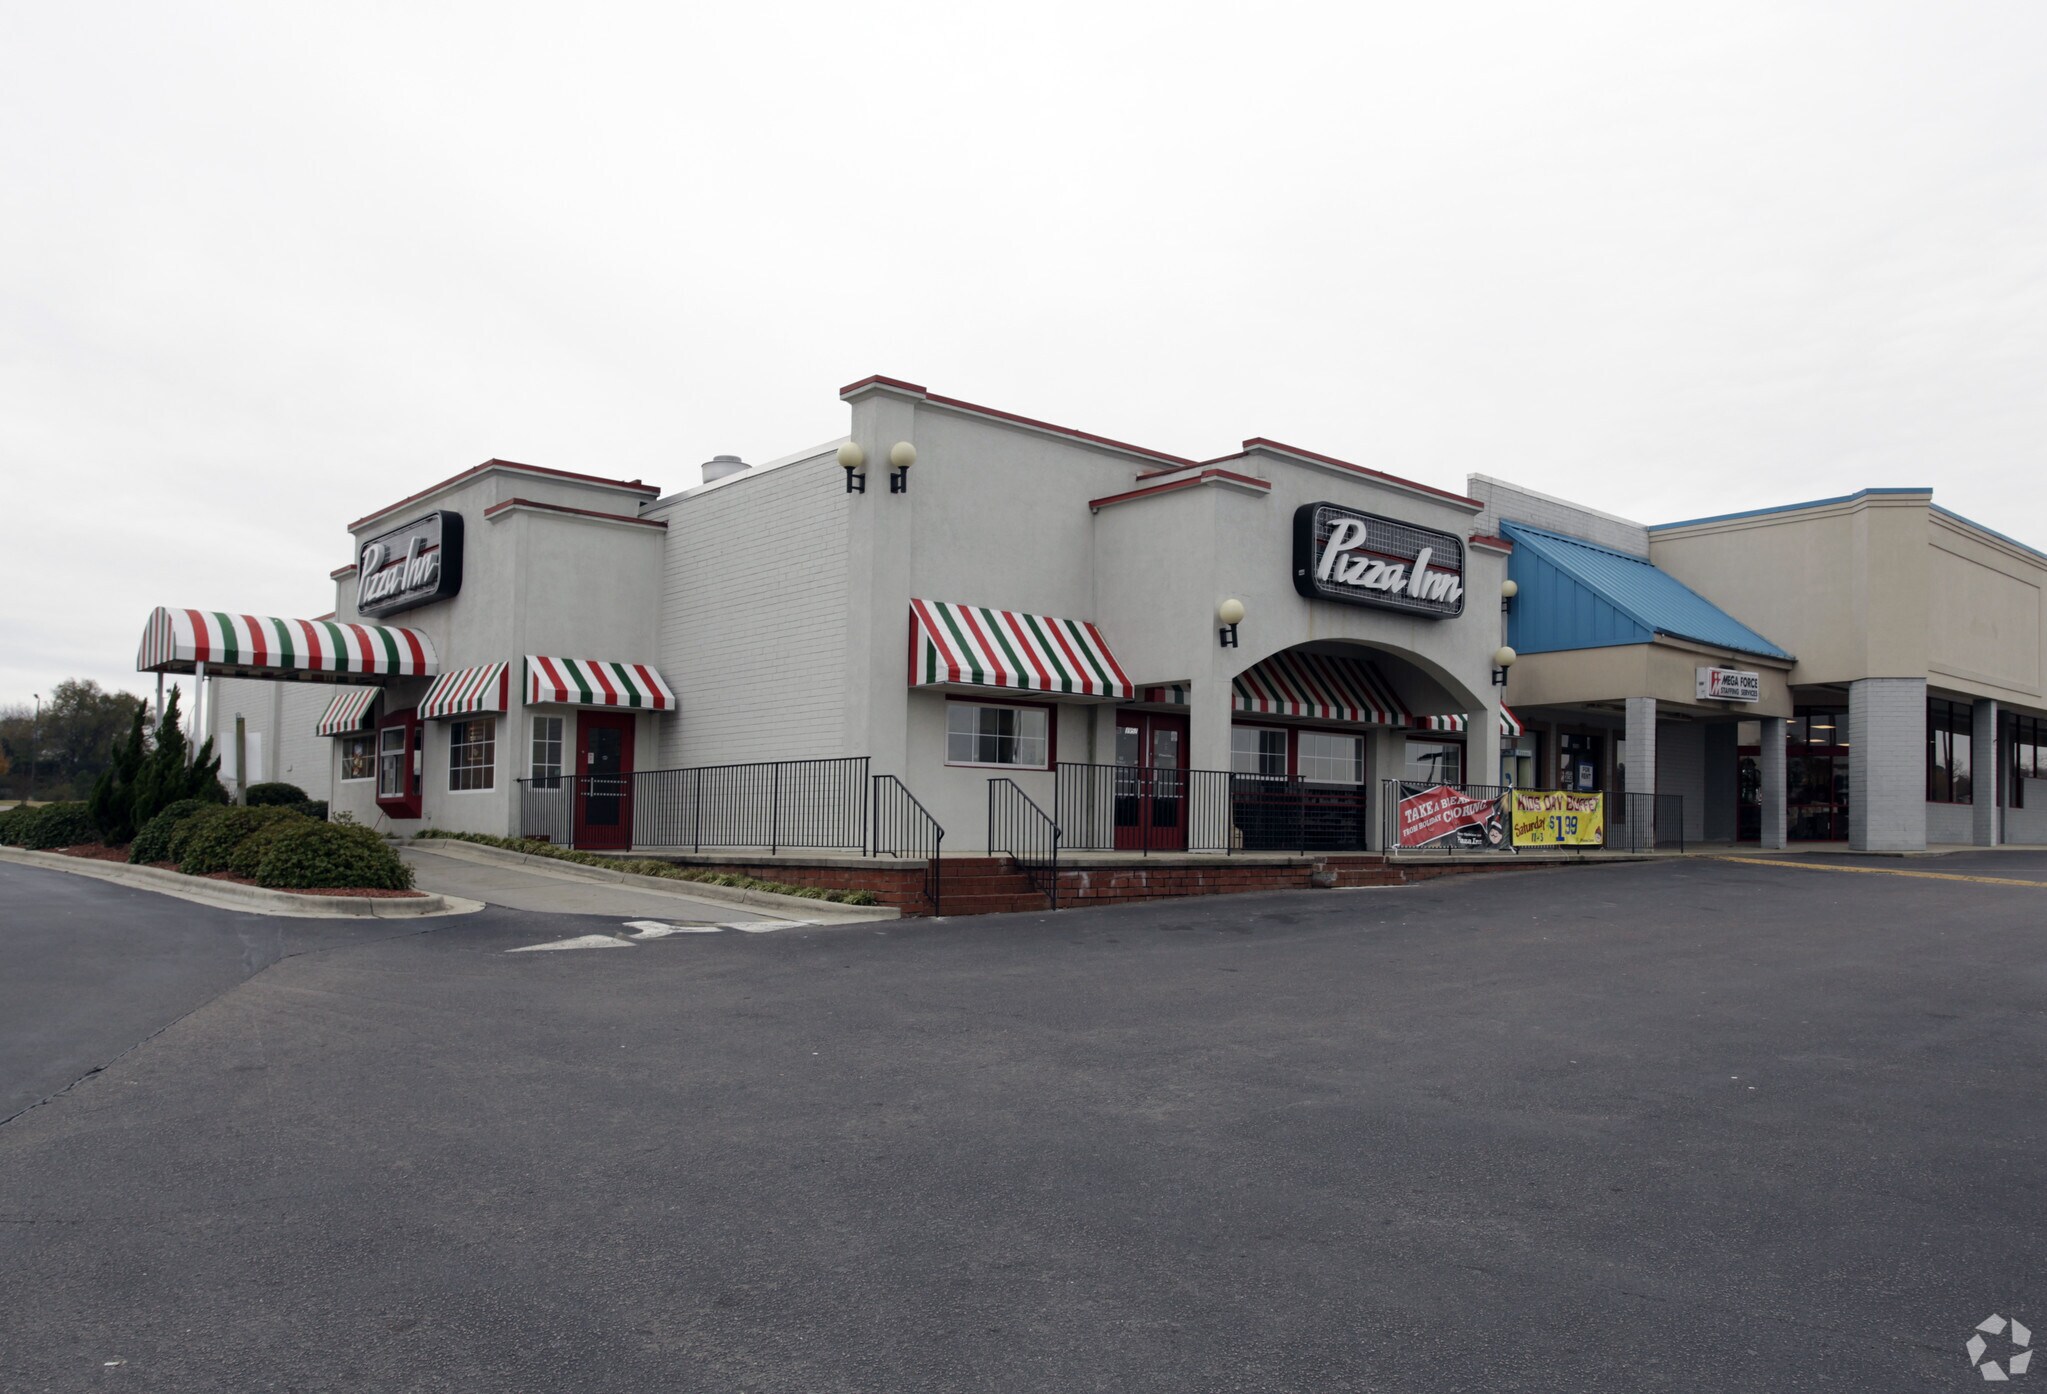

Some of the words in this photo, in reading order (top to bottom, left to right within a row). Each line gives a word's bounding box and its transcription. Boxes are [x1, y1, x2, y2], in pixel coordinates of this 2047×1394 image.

[357, 543, 403, 606] Pizza
[401, 536, 440, 591] Inn
[1317, 518, 1407, 594] Pizza
[1407, 547, 1463, 603] Inn
[1720, 687, 1739, 695] STAFFING
[1740, 689, 1758, 697] SERVICES
[1722, 675, 1738, 686] MEGA
[1740, 677, 1758, 688] FORCE
[1405, 801, 1434, 823] TAKE
[1434, 802, 1440, 812] A
[1517, 794, 1541, 811] KIDS
[1543, 795, 1563, 811] DAY
[1566, 795, 1599, 812] BUFFET
[1402, 824, 1418, 837] FROM
[1418, 814, 1442, 830] HOLIDAY
[1514, 816, 1546, 837] Saturday
